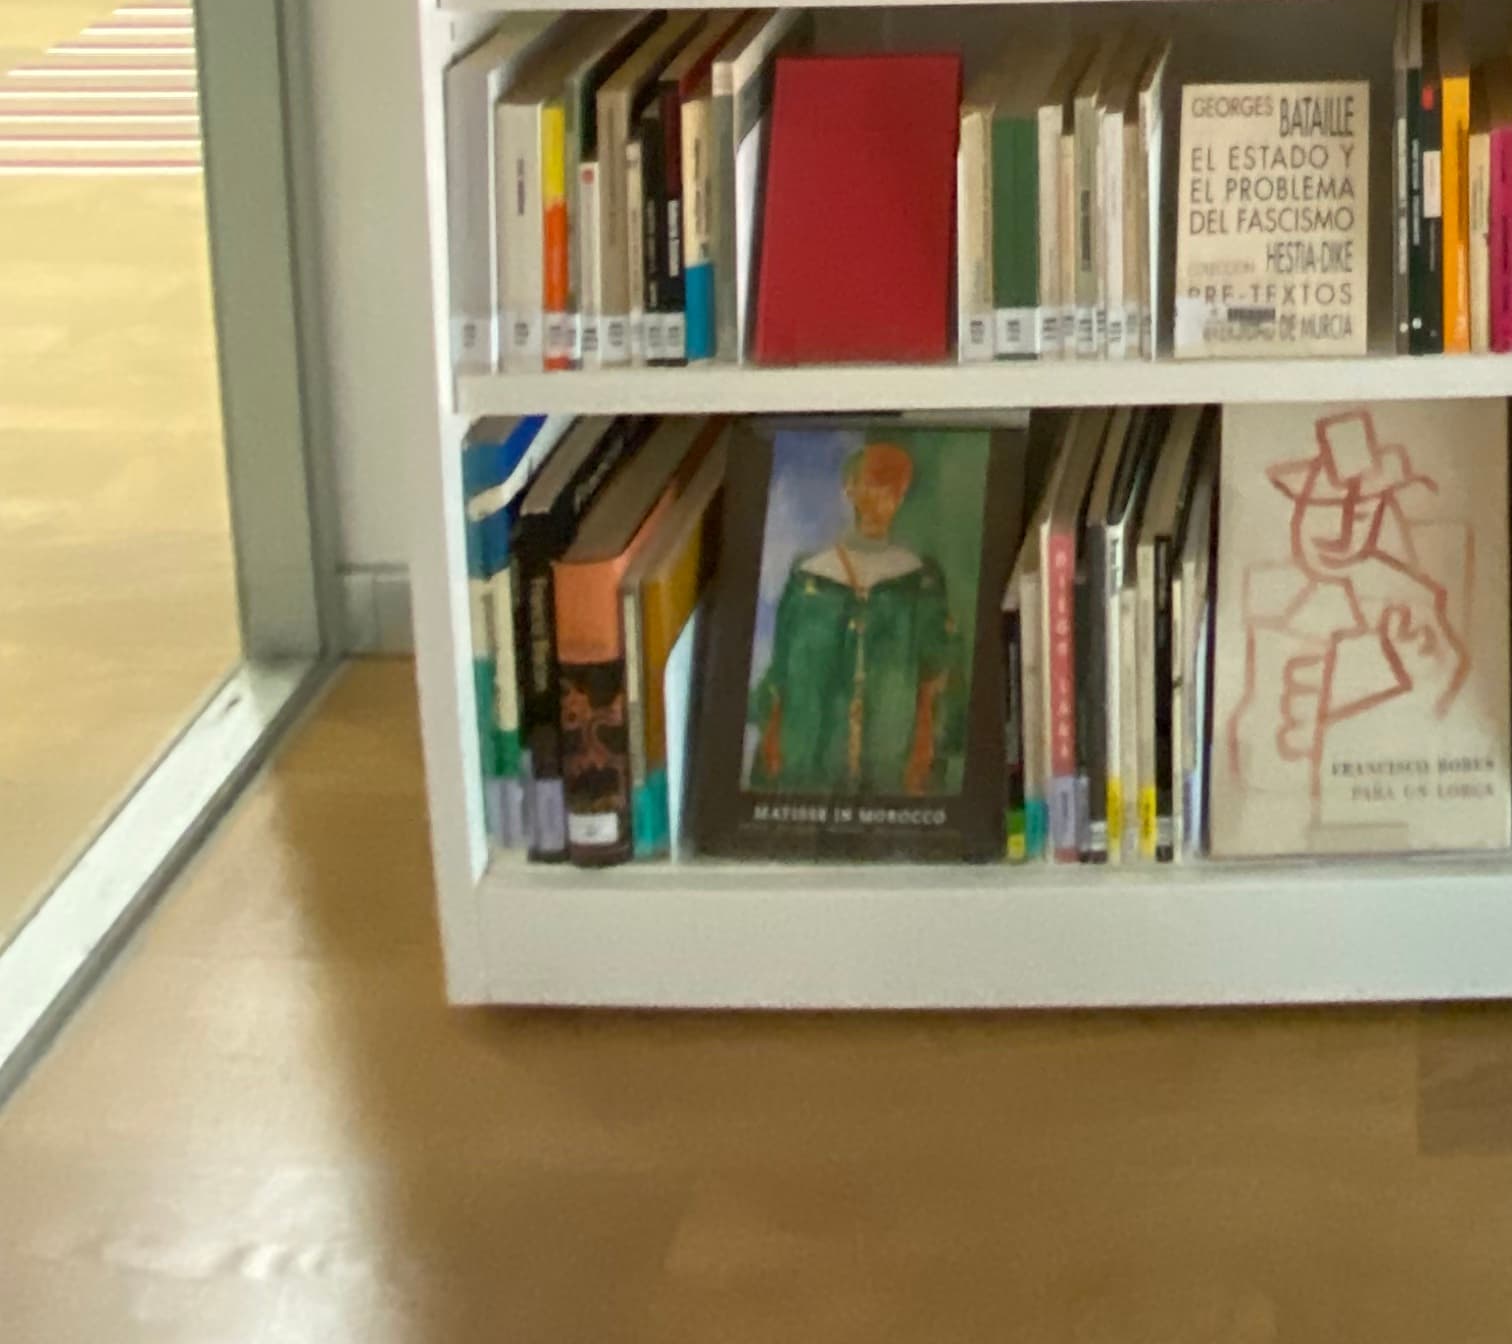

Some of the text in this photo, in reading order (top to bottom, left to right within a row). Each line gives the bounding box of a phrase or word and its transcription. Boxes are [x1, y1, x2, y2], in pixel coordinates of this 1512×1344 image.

[1191, 96, 1356, 139] GEORGES BATAILLE
[1191, 144, 1354, 172] EL ESTADO Y
[1190, 176, 1355, 202] EL PROBLEMA
[1189, 206, 1355, 234] DEL FASCISMO
[1301, 313, 1353, 340] MURCIA
[1331, 760, 1429, 777] FRANCISCO
[753, 805, 947, 826] MATISSE IN MOROCCO
